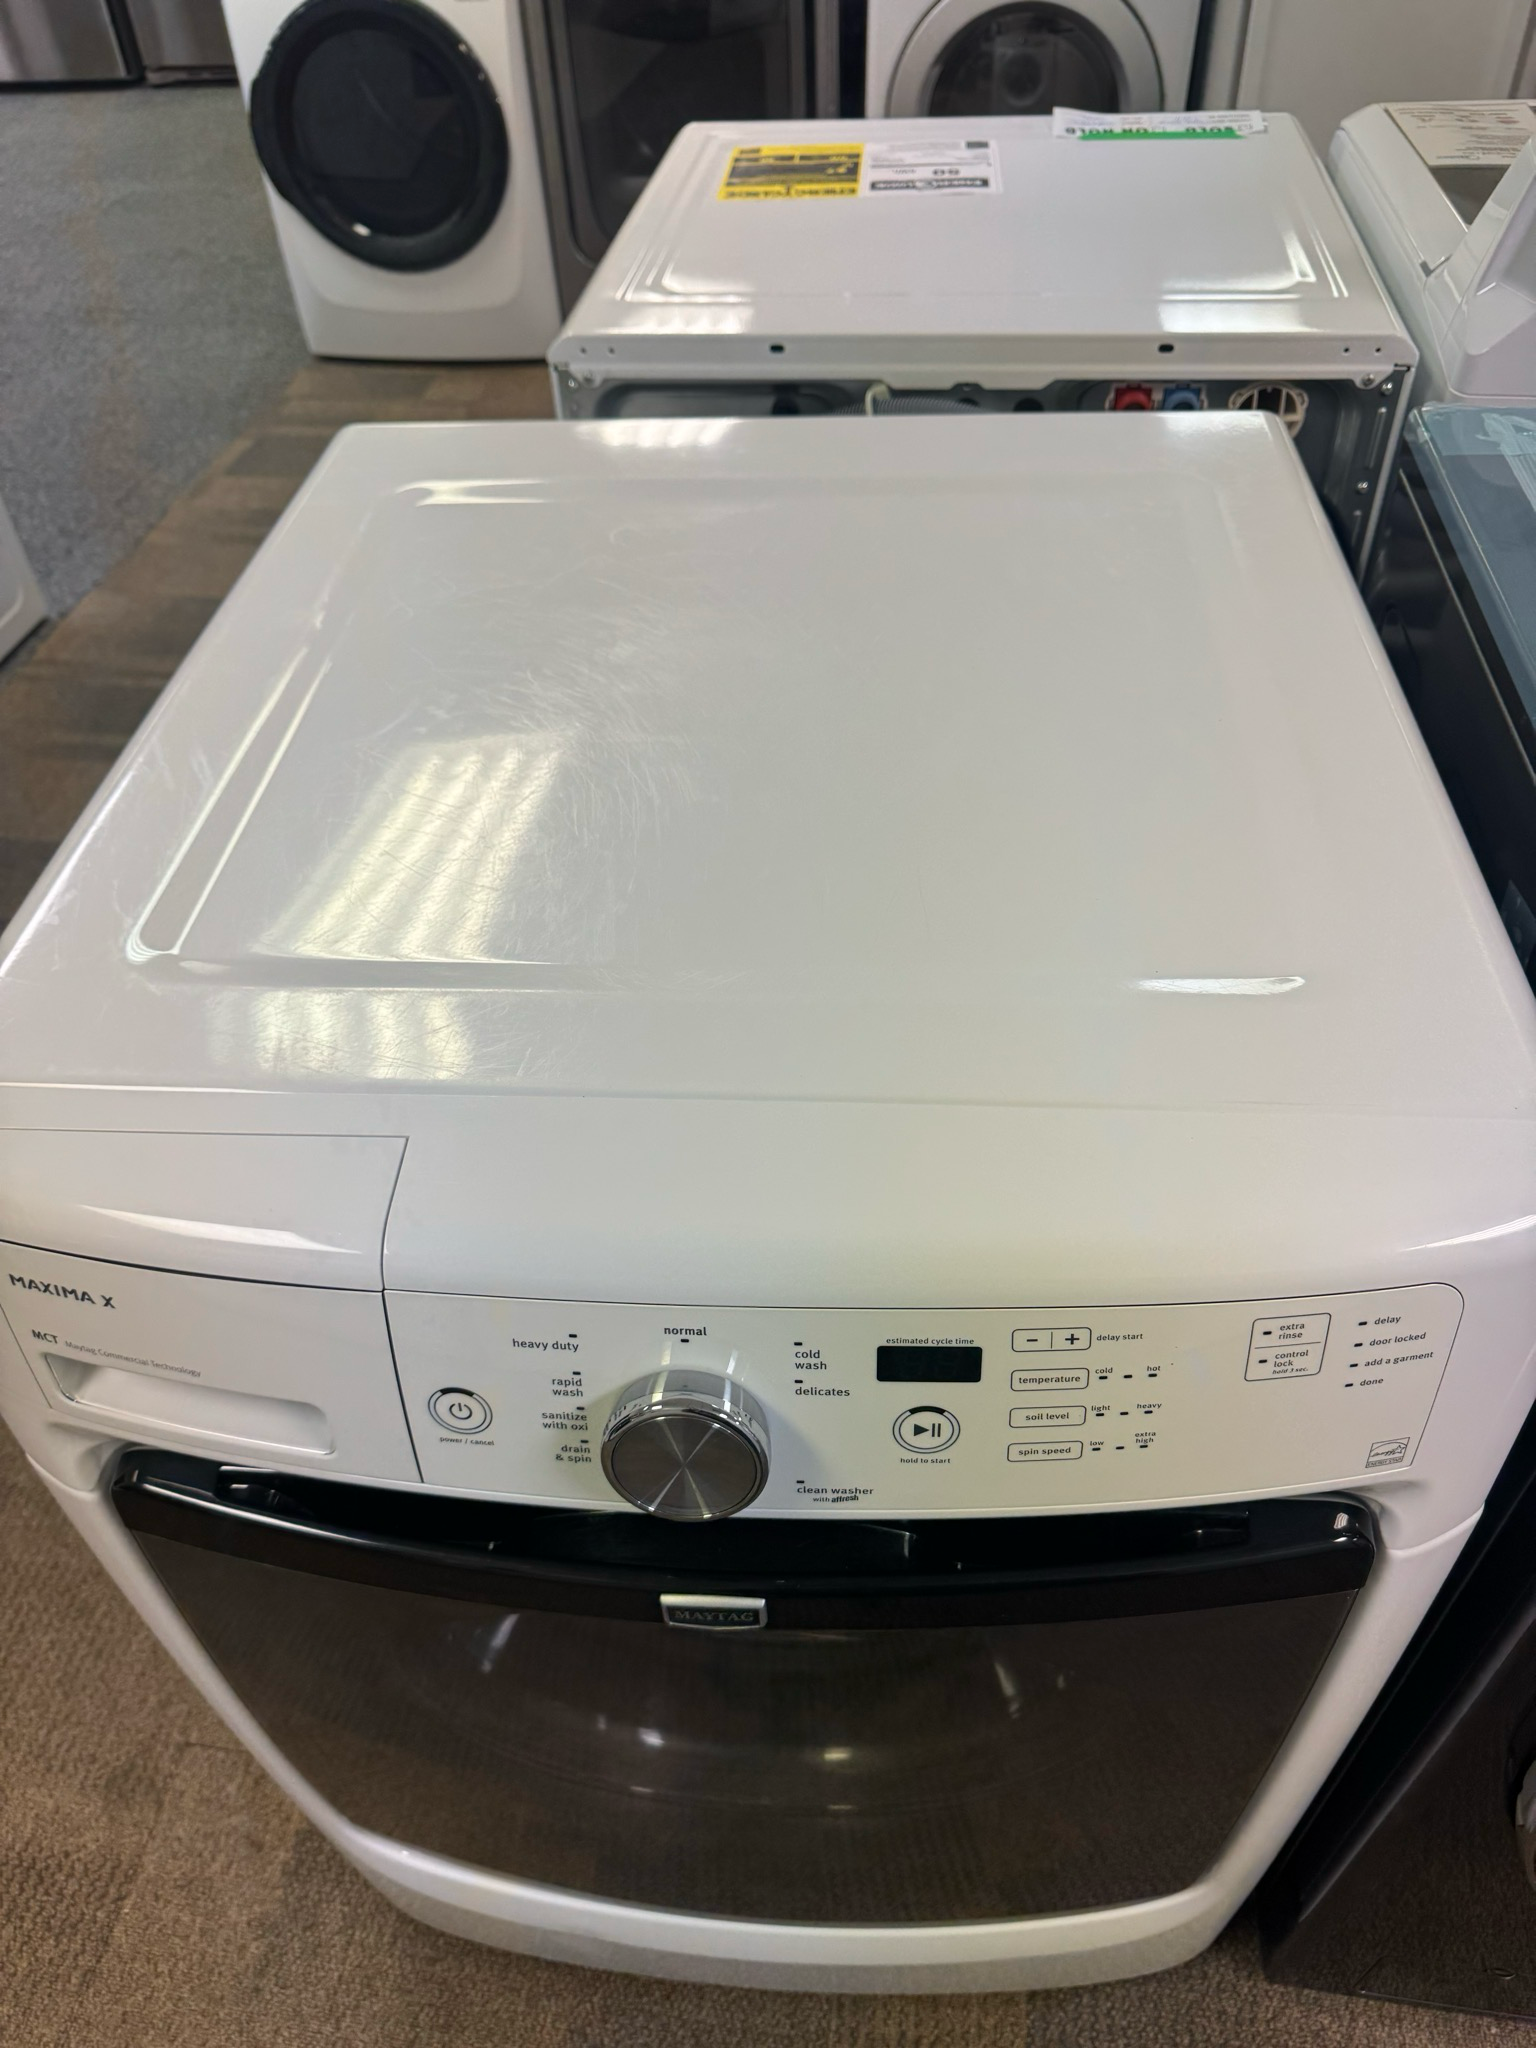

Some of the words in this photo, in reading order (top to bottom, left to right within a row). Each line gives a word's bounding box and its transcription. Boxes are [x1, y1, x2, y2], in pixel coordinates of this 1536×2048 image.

[9, 1274, 96, 1305] MAXIMA
[102, 1295, 115, 1309] X
[1375, 1316, 1401, 1325] delay
[664, 1327, 706, 1336] normal
[1280, 1323, 1304, 1331] extra
[1097, 1333, 1120, 1342] delay
[1123, 1333, 1142, 1341] start
[1279, 1332, 1302, 1340] rinse
[1370, 1338, 1392, 1347] door
[1395, 1332, 1426, 1343] locked
[513, 1338, 548, 1351] heavy
[552, 1340, 578, 1353] duty
[886, 1337, 928, 1345] estimated
[931, 1337, 953, 1345] cycle
[956, 1337, 974, 1345] time
[32, 1329, 57, 1344] MCT
[65, 1340, 97, 1356] Maytag
[98, 1348, 149, 1367] Commercial
[150, 1359, 201, 1378] Technology
[795, 1349, 820, 1359] cold
[1275, 1349, 1308, 1359] control
[1274, 1358, 1293, 1368] lock
[1365, 1357, 1383, 1367] add
[1393, 1351, 1433, 1365] garment
[795, 1361, 826, 1370] wash
[1095, 1366, 1113, 1375] cold
[552, 1377, 582, 1388] rapid
[1019, 1375, 1080, 1384] temperature
[1360, 1378, 1383, 1387] done
[553, 1388, 583, 1397] wash
[795, 1386, 850, 1397] delicates
[1091, 1404, 1110, 1413] light
[1137, 1403, 1161, 1411] heavy
[542, 1411, 588, 1421] sanitize
[1026, 1412, 1043, 1421] soil
[1046, 1412, 1069, 1420] level
[543, 1421, 567, 1430] with
[572, 1422, 588, 1431] oxi
[440, 1436, 462, 1444] power
[1136, 1436, 1153, 1445] high
[561, 1444, 590, 1454] drain
[1019, 1448, 1038, 1457] spin
[1042, 1446, 1071, 1455] speed
[556, 1453, 564, 1461] &
[568, 1454, 591, 1464] spin
[797, 1486, 827, 1494] clean
[831, 1486, 874, 1496] washer
[831, 1494, 859, 1503] affresh
[674, 1610, 754, 1621] MAYTAG
